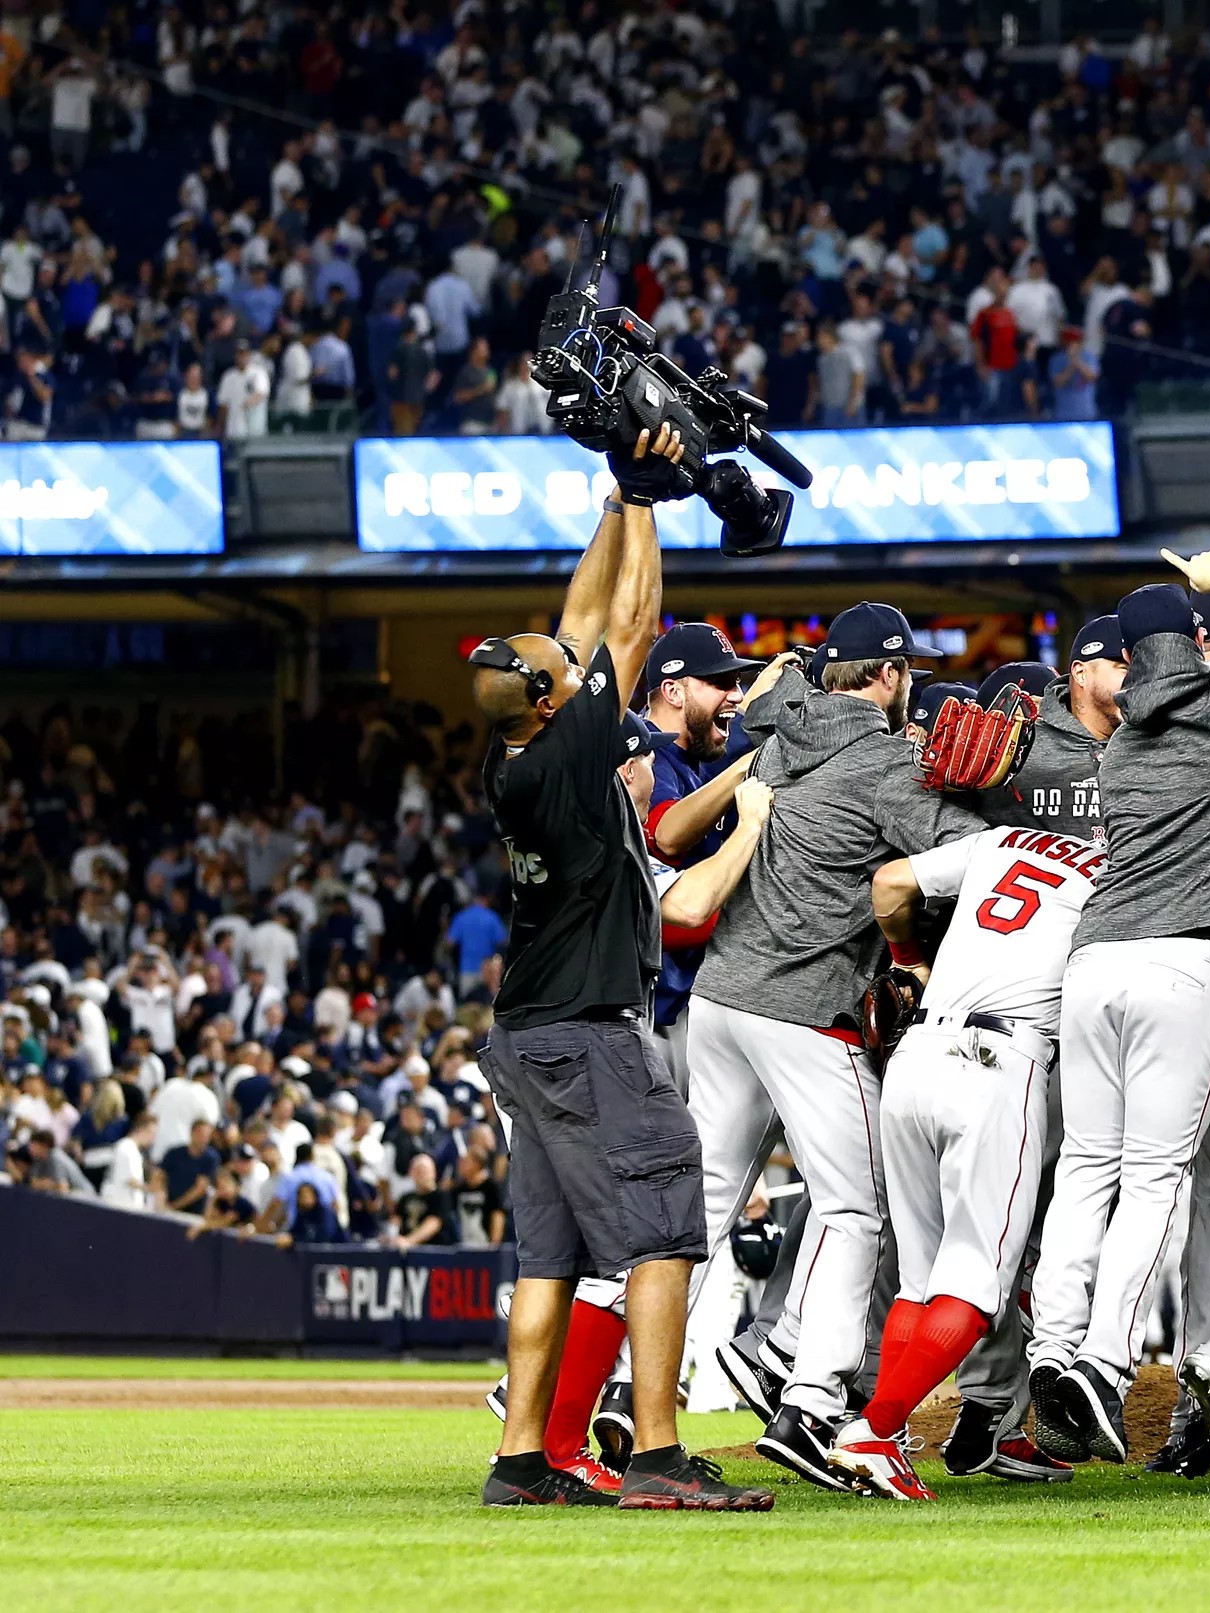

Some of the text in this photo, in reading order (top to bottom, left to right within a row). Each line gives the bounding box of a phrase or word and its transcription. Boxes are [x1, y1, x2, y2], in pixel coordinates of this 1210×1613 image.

[384, 470, 523, 517] RED
[809, 457, 1090, 510] YANKEES
[1032, 788, 1101, 818] DO DA
[998, 829, 1109, 887] KINSLE
[976, 859, 1067, 935] 5
